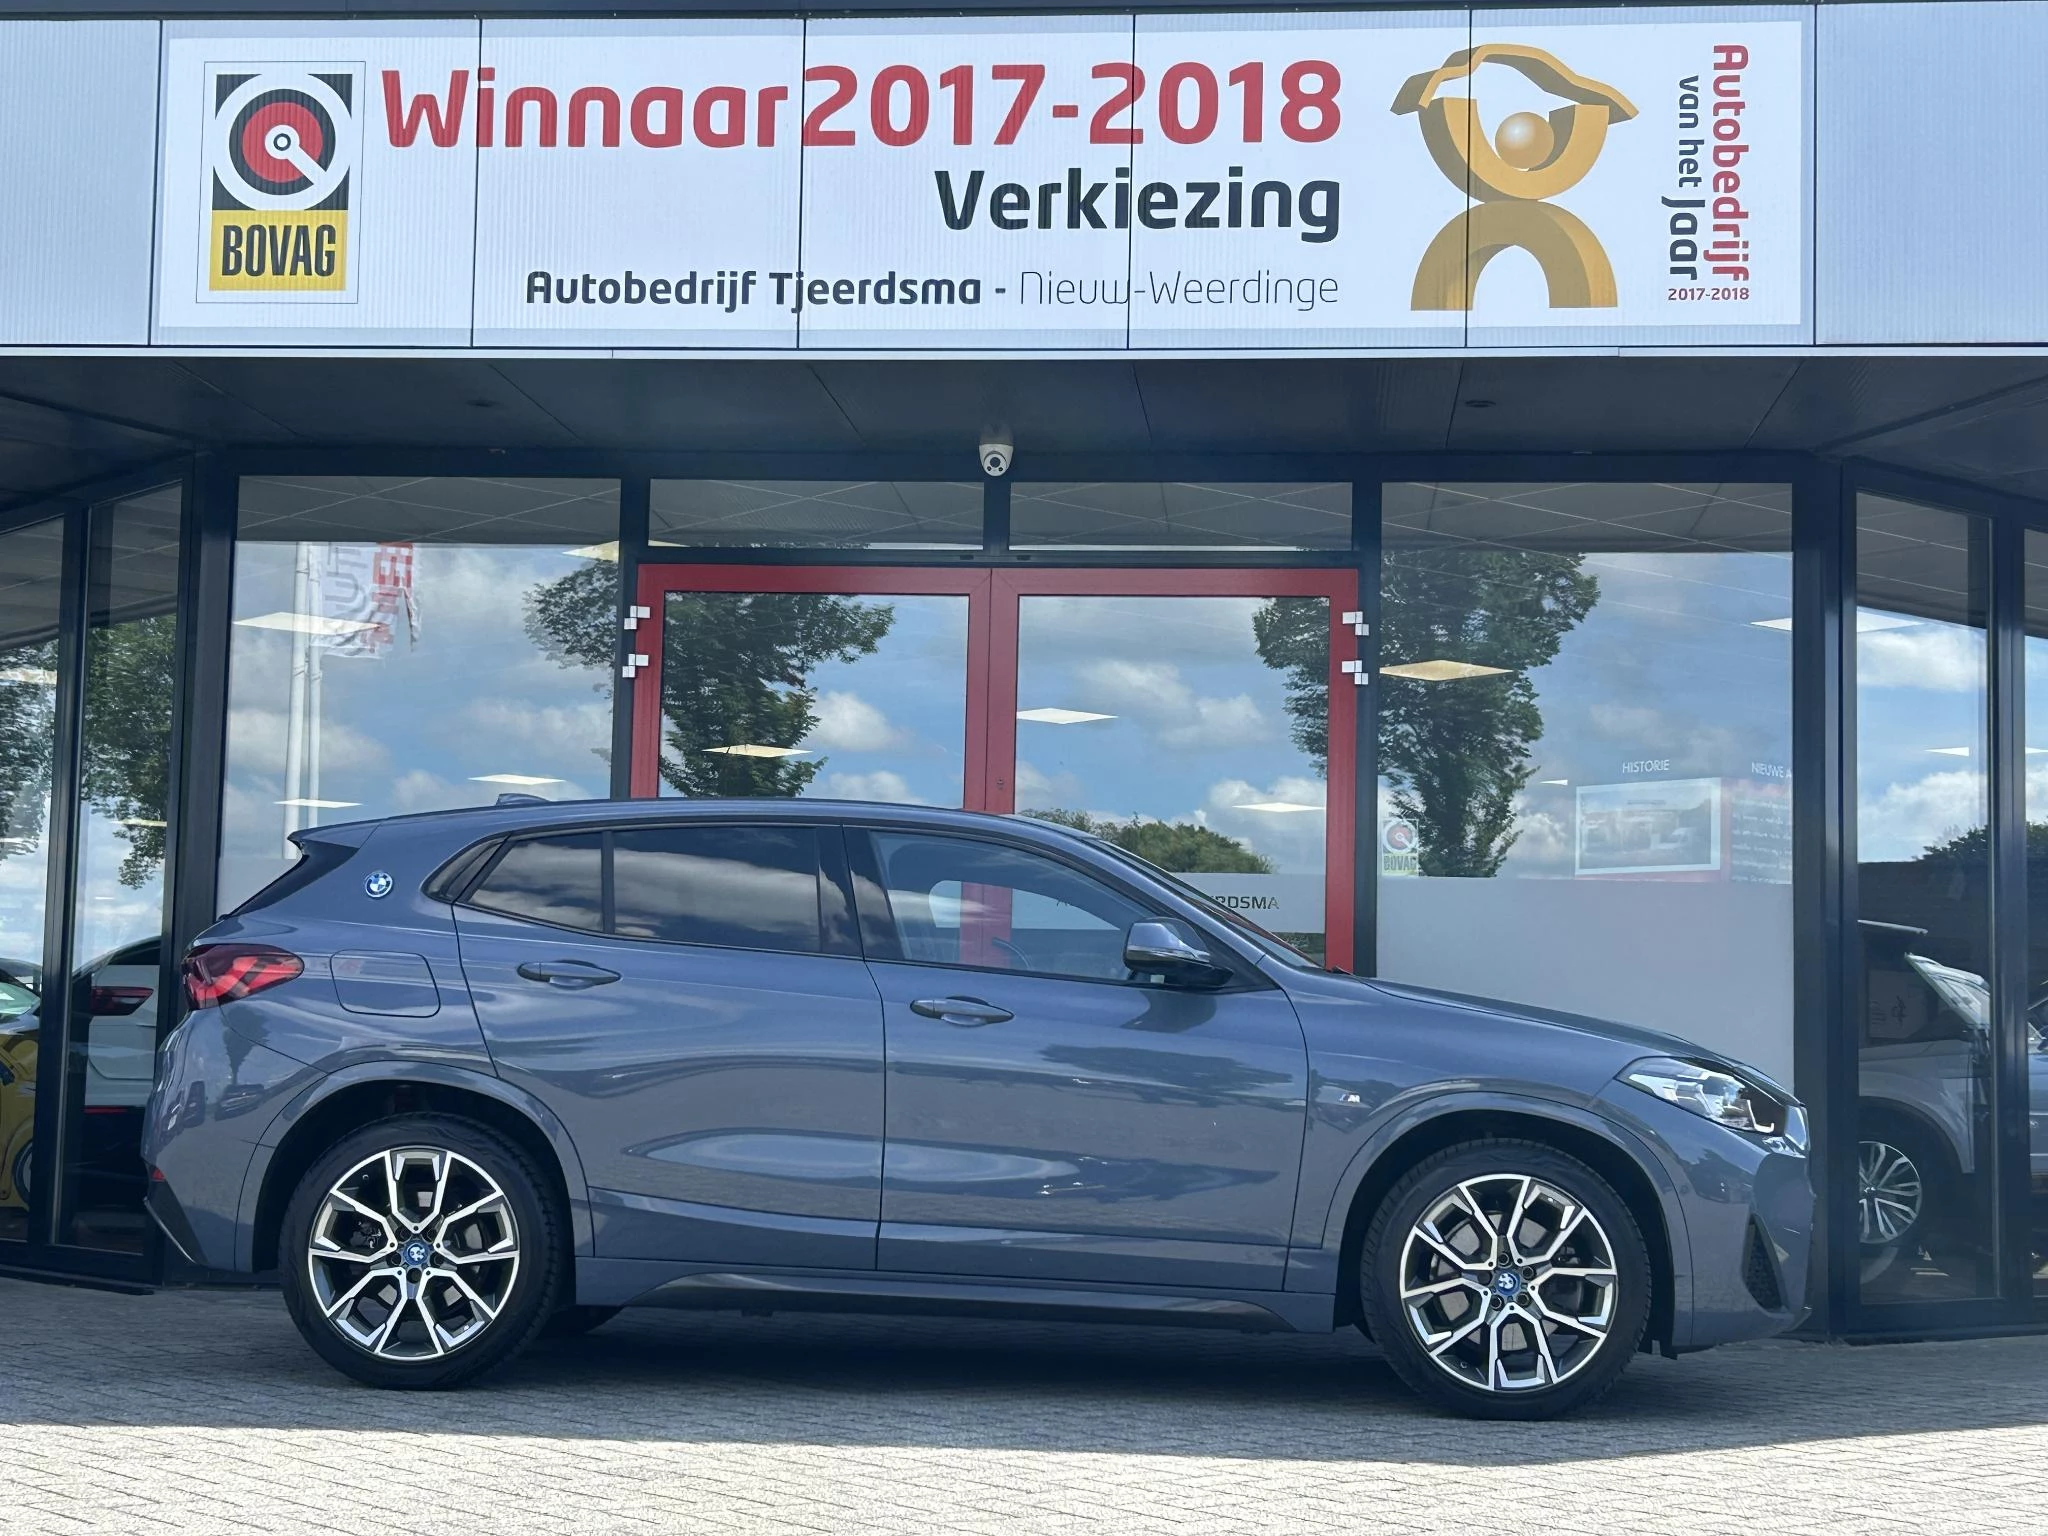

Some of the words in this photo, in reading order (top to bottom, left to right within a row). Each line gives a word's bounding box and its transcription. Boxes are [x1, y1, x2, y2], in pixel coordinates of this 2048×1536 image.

[382, 66, 789, 149] Winnaar
[803, 60, 1342, 147] 2017-2018
[1678, 75, 1699, 129] van
[1678, 139, 1705, 188] het
[1703, 44, 1750, 281] Autobedrijf
[934, 165, 1342, 244] Verkiezing
[221, 223, 337, 278] BOVAG
[1661, 195, 1706, 281] Jaar
[526, 269, 758, 314] Autobedrijf
[768, 269, 982, 314] Tjeerdsma
[1020, 269, 1339, 312] Nieuw-Weerdinge
[1667, 286, 1750, 301] 2017-2018
[1622, 759, 1670, 774] HISTORIE
[1751, 761, 1784, 778] NIEUWE
